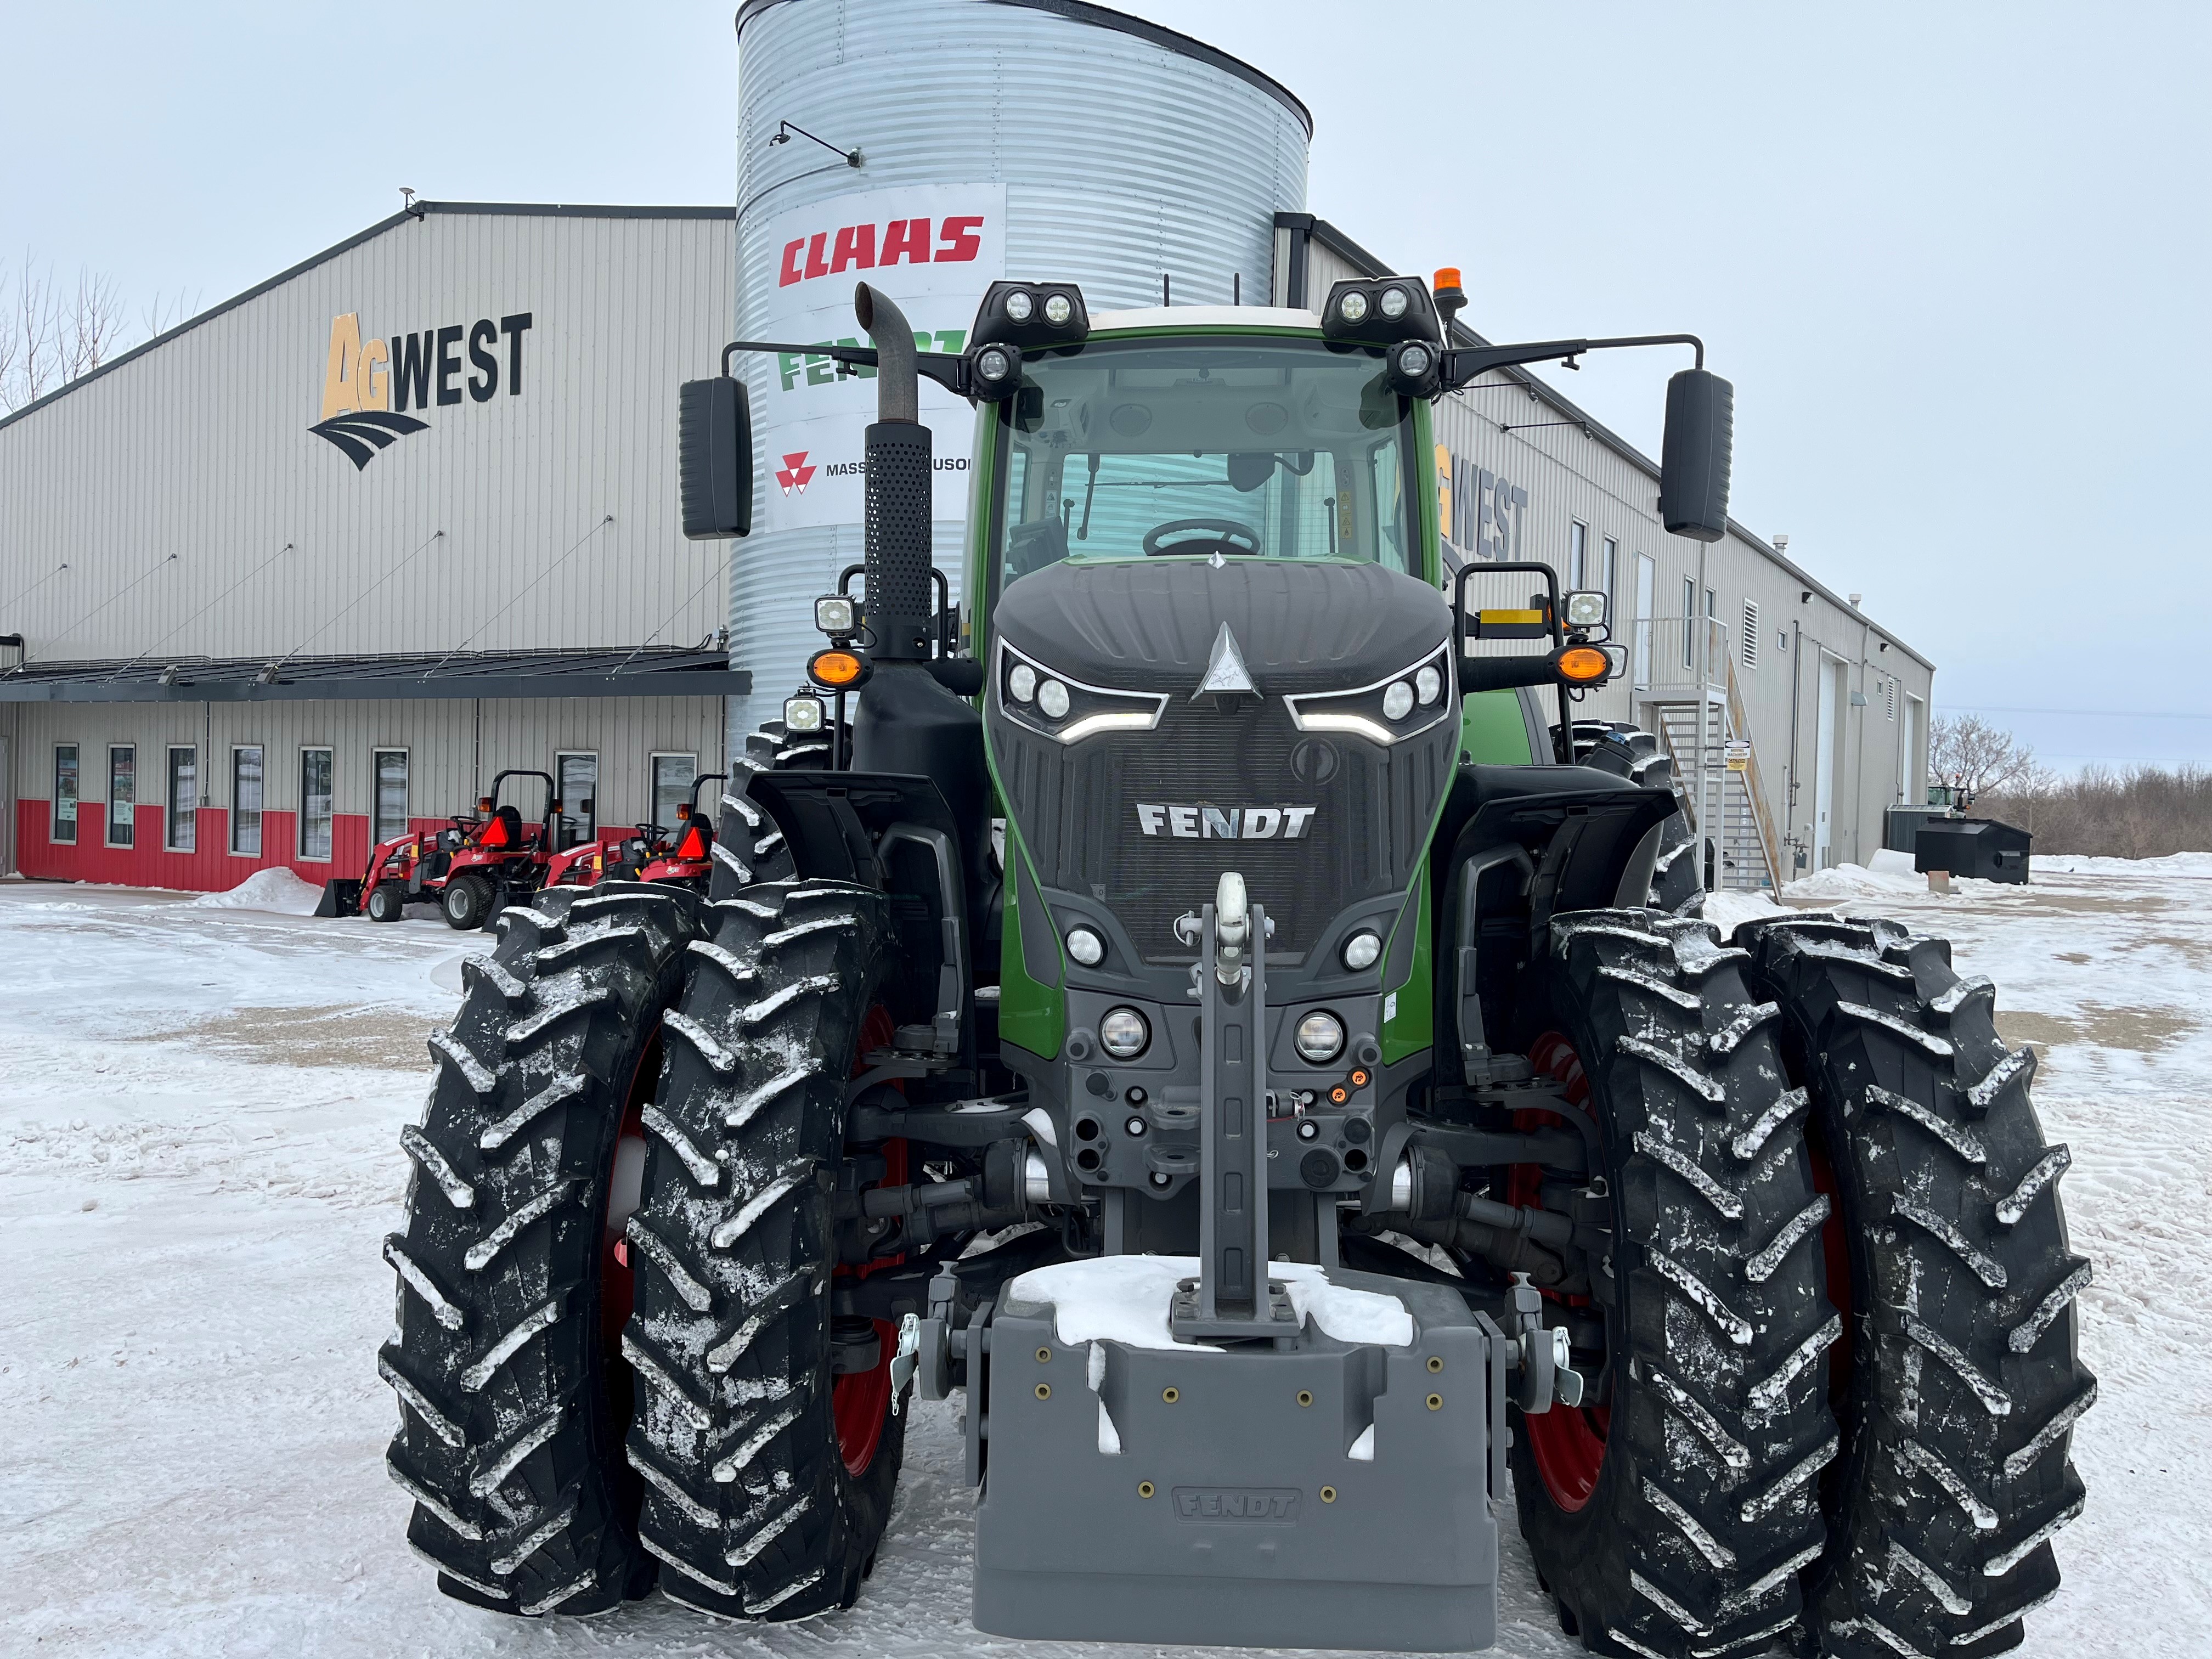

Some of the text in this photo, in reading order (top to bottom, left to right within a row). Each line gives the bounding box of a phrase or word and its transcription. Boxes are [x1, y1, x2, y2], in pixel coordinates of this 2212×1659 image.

[778, 216, 984, 287] CLAAS
[777, 330, 967, 392] FENT
[1136, 803, 1317, 839] FENDT
[1177, 1494, 1295, 1518] FENDT
